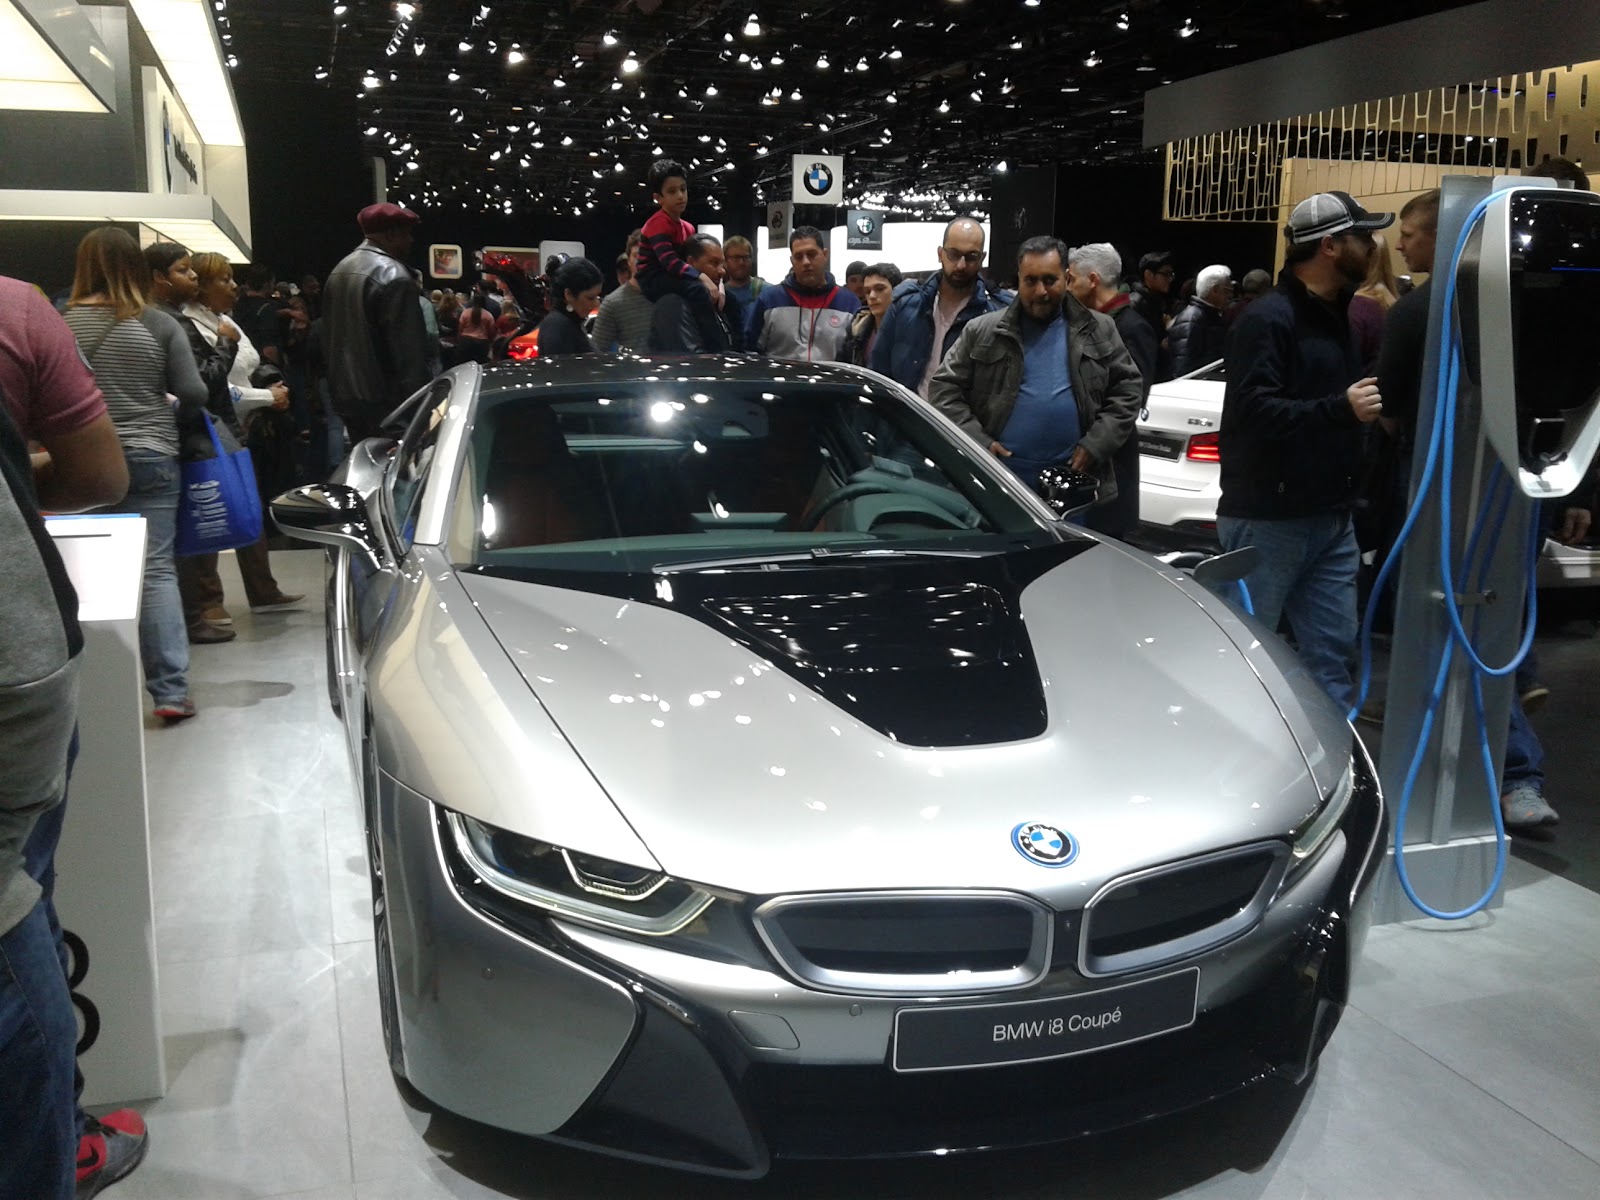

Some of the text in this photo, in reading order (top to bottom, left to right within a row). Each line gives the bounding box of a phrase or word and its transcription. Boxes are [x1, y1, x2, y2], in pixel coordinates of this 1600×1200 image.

[993, 1006, 1122, 1041] BMW i8 Coupé
